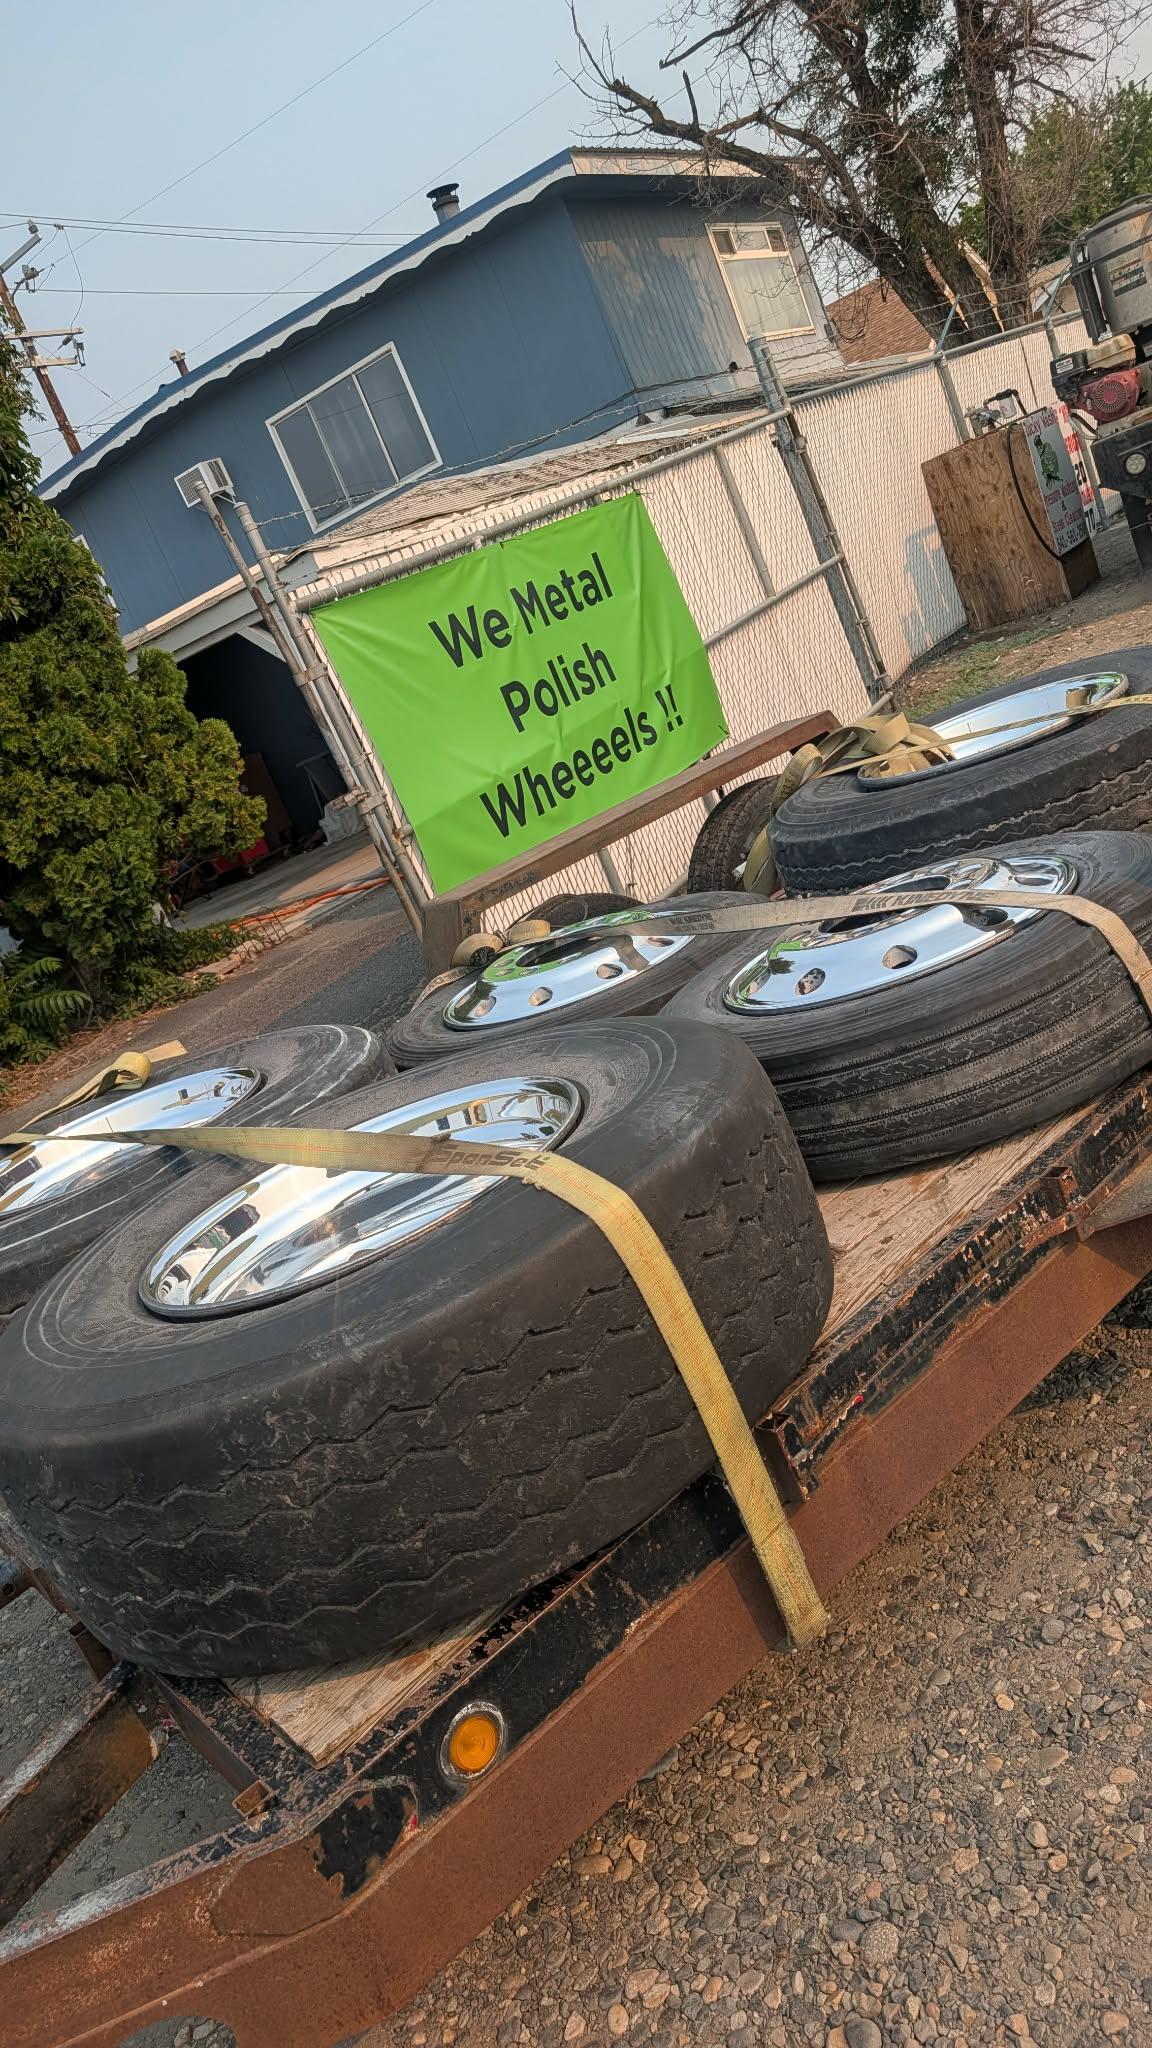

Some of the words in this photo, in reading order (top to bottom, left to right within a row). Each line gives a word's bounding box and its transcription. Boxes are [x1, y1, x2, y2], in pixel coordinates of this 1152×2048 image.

[428, 605, 512, 668] We
[510, 552, 614, 635] Metal
[500, 642, 617, 733] Polish
[480, 707, 659, 838] Wheeeels
[431, 1143, 549, 1170] SpanSet
